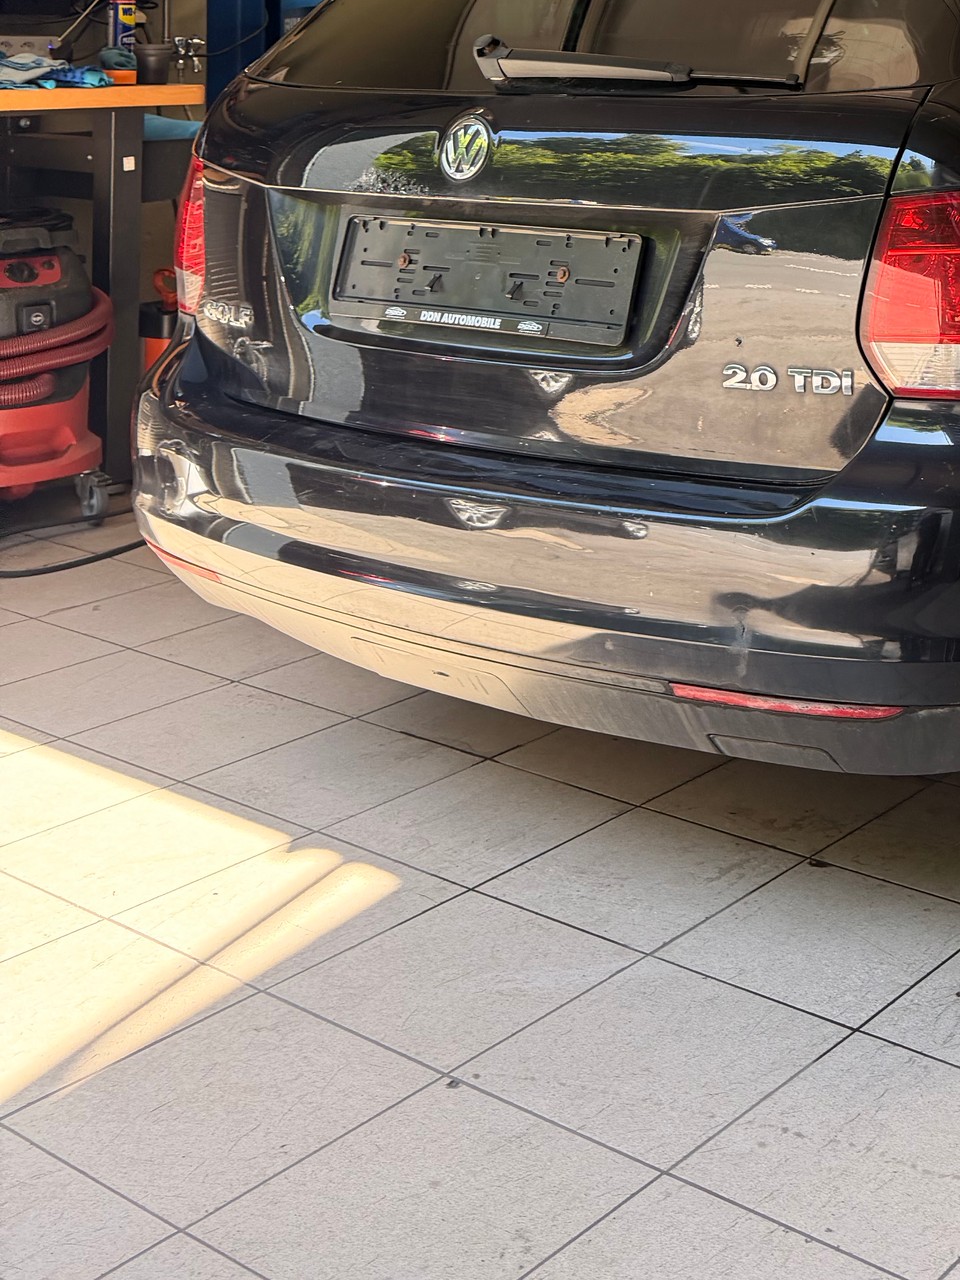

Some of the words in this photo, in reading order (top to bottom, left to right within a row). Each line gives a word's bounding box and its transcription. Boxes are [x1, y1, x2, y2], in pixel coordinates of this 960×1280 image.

[203, 299, 255, 328] GOLF
[419, 310, 442, 322] DDN
[442, 314, 502, 329] AUTOMOBILE
[788, 368, 853, 396] TDI
